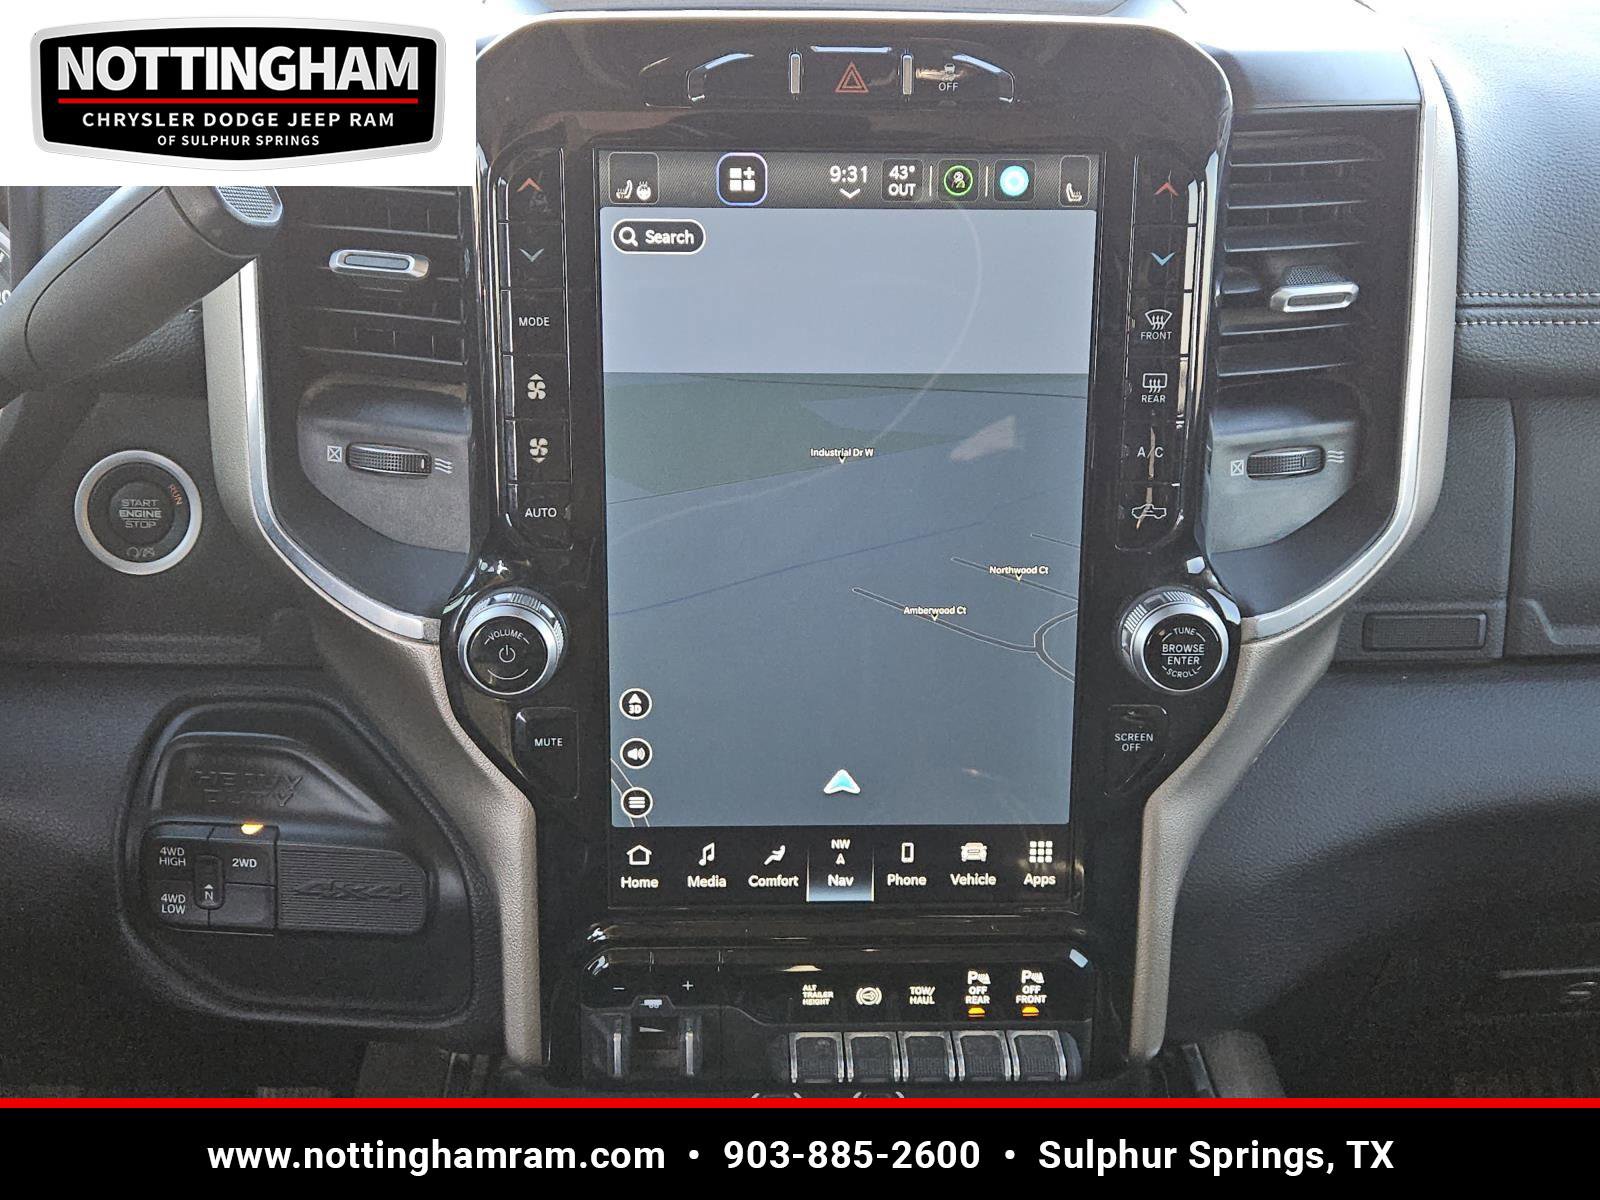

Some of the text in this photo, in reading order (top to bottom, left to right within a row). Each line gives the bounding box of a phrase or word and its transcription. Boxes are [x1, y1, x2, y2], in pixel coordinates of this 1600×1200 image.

[938, 82, 959, 91] OFF
[829, 165, 868, 183] 9:31
[889, 165, 916, 180] 43°
[888, 183, 917, 197] OUT
[644, 229, 695, 246] Search
[518, 316, 550, 327] MODE
[1140, 331, 1172, 340] FRONT
[1141, 394, 1166, 403] REAR
[810, 447, 874, 457] Industrial Dr W
[1137, 446, 1164, 459] A/C
[168, 483, 183, 505] RUN
[121, 499, 158, 507] START
[119, 509, 162, 518] ENGINE
[525, 507, 557, 518] AUTO
[125, 520, 156, 529] STOP
[989, 566, 1049, 574] Northwood Ct
[903, 606, 967, 615] Amberwood Ct
[488, 628, 524, 642] VOLUME
[1173, 626, 1197, 636] TUNE
[1161, 643, 1205, 653] BROWSE
[1167, 655, 1200, 665] ENTER
[1166, 667, 1199, 678] SCROLL
[628, 703, 642, 715] 3D
[534, 737, 563, 747] MUTE
[1114, 733, 1154, 742] SCREEN
[1121, 743, 1141, 752] OFF
[831, 838, 850, 850] NW
[159, 846, 185, 857] 4WD
[159, 857, 187, 867] HIGH
[232, 858, 257, 869] 2WD
[620, 875, 659, 889] Home
[687, 875, 727, 888] Media
[748, 874, 799, 888] Comfort
[827, 873, 854, 887] Nav
[887, 873, 927, 886] Phone
[950, 872, 997, 886] Vehicle
[1023, 872, 1056, 888] Apps
[160, 893, 186, 904] 4WD
[204, 891, 214, 901] N
[161, 904, 186, 915] LOW
[910, 986, 936, 997] TOW/
[968, 986, 988, 995] OFF
[1022, 985, 1041, 995] OFF
[909, 995, 935, 1005] HAUL
[965, 995, 990, 1004] REAR
[1016, 994, 1047, 1004] FRONT
